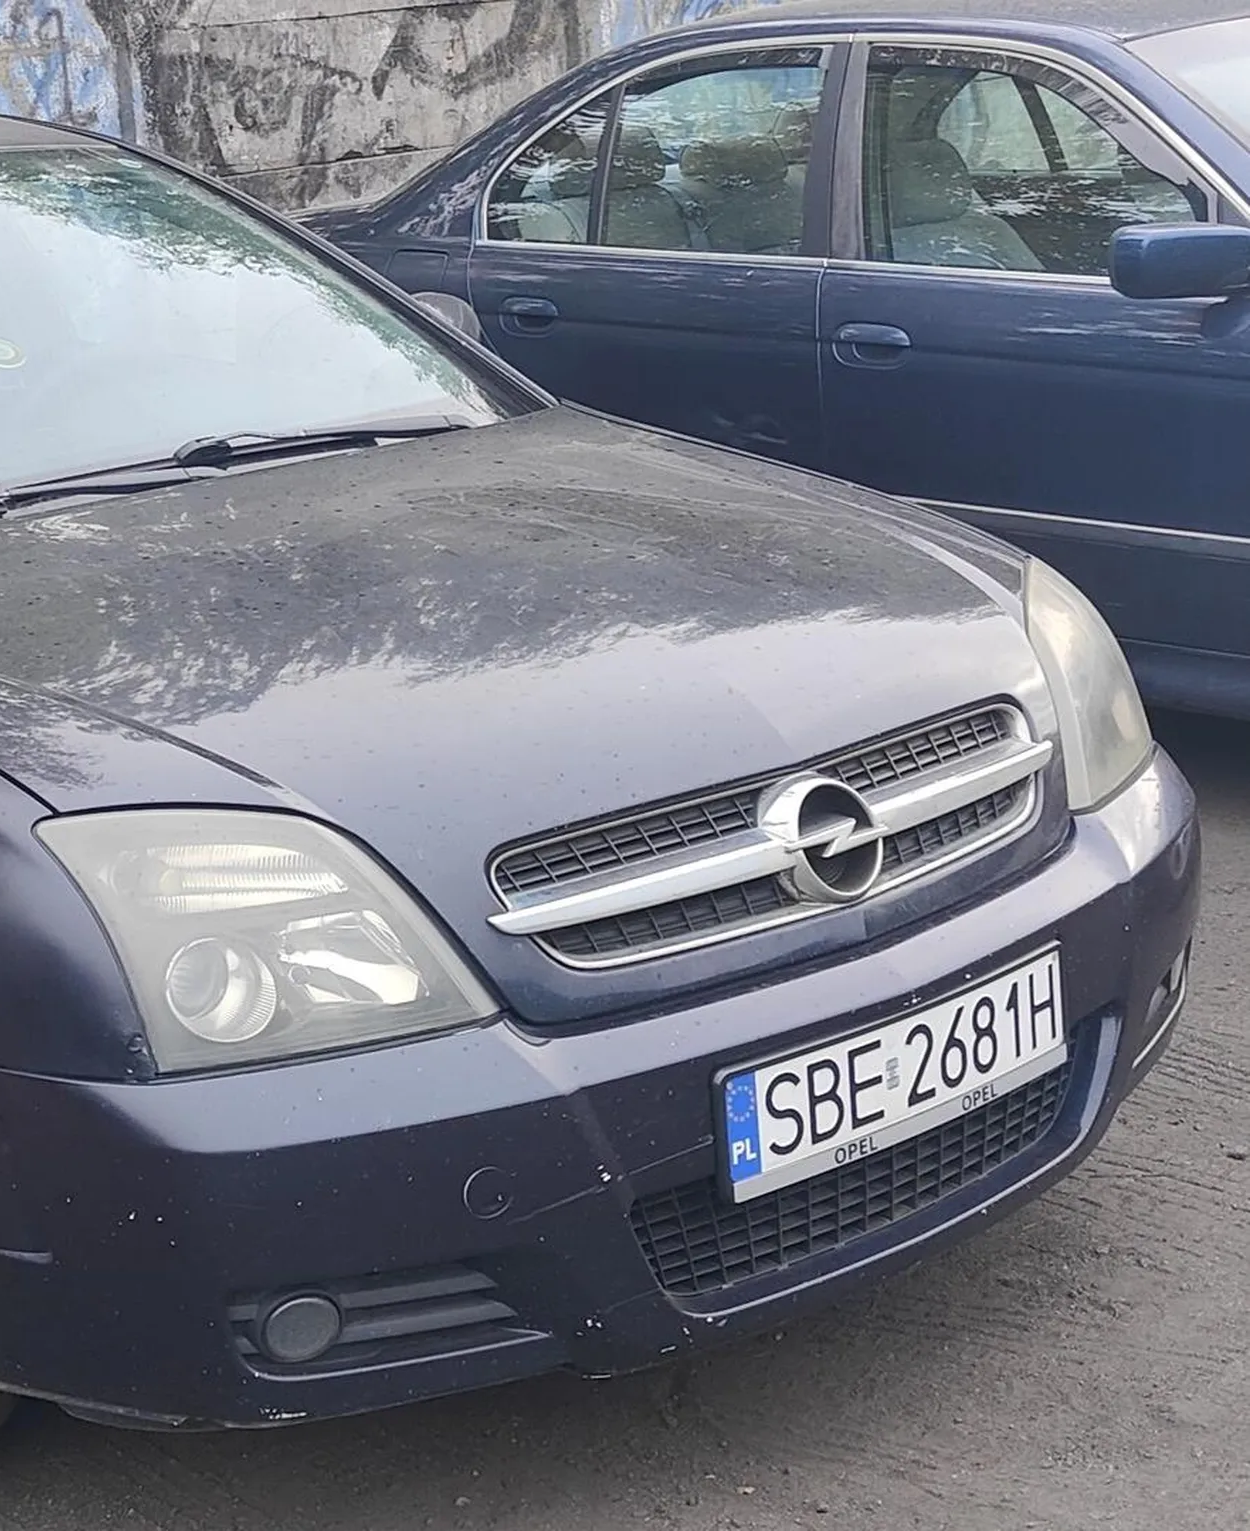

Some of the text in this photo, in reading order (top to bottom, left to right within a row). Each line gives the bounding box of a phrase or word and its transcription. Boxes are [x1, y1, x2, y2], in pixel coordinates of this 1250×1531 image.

[764, 963, 1057, 1156] SBE 2681H
[961, 1083, 999, 1111] OPEL
[732, 1137, 757, 1165] PL
[834, 1136, 879, 1165] OPEL
